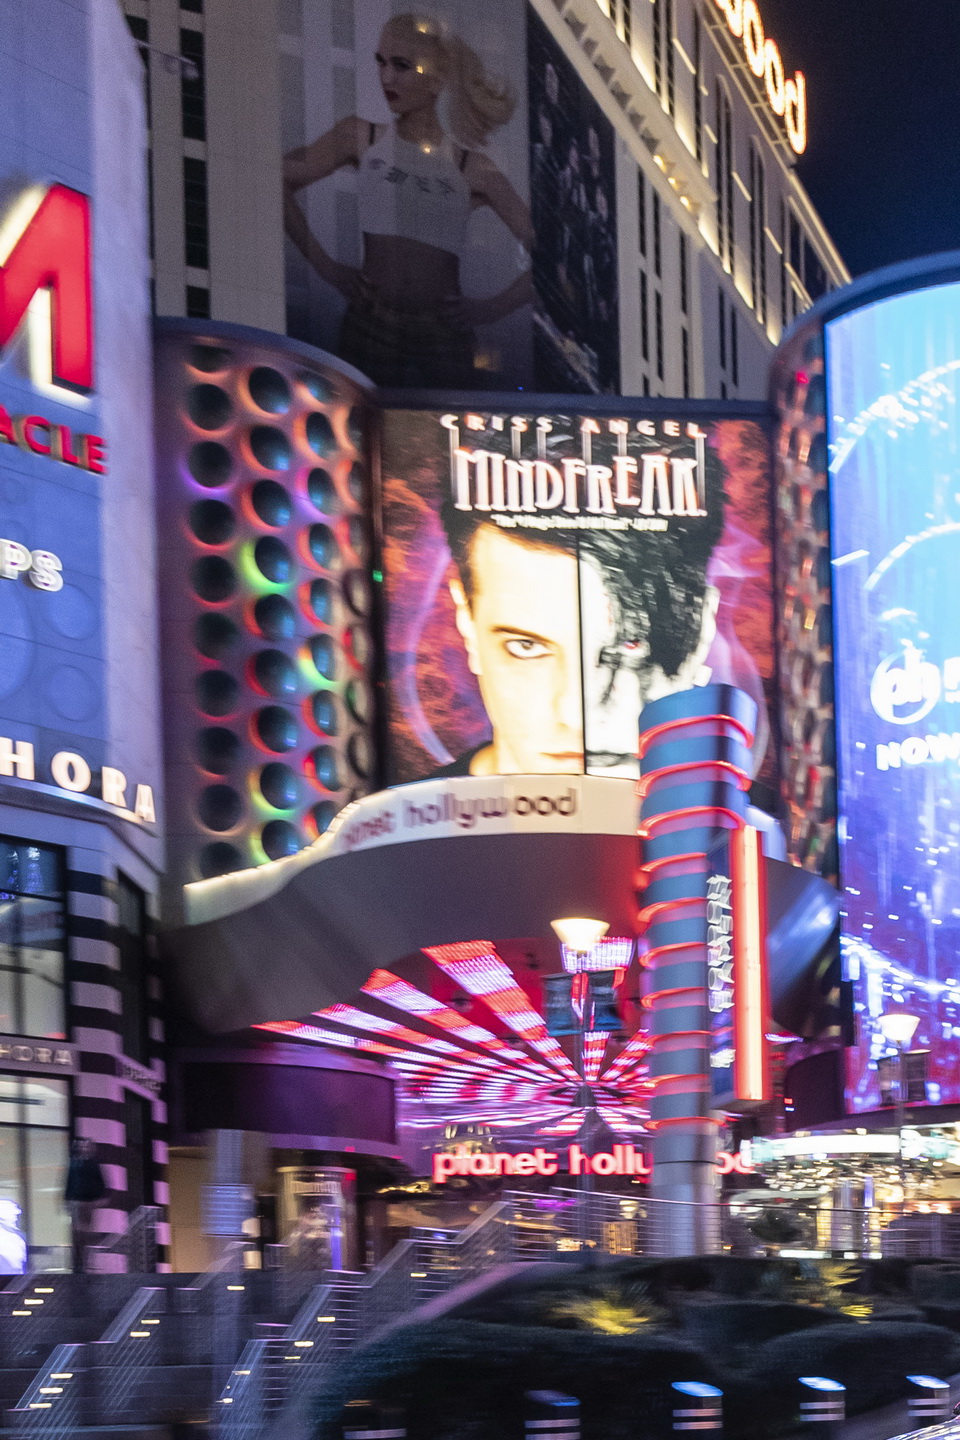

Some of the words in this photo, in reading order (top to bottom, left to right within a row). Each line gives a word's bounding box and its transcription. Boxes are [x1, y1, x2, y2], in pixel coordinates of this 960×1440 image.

[440, 413, 553, 433] CRISS
[580, 417, 708, 439] ANGEL
[453, 446, 708, 517] MINDFREAK
[0, 538, 64, 592] PS
[0, 736, 157, 824] HORA
[432, 1144, 559, 1184] planet
